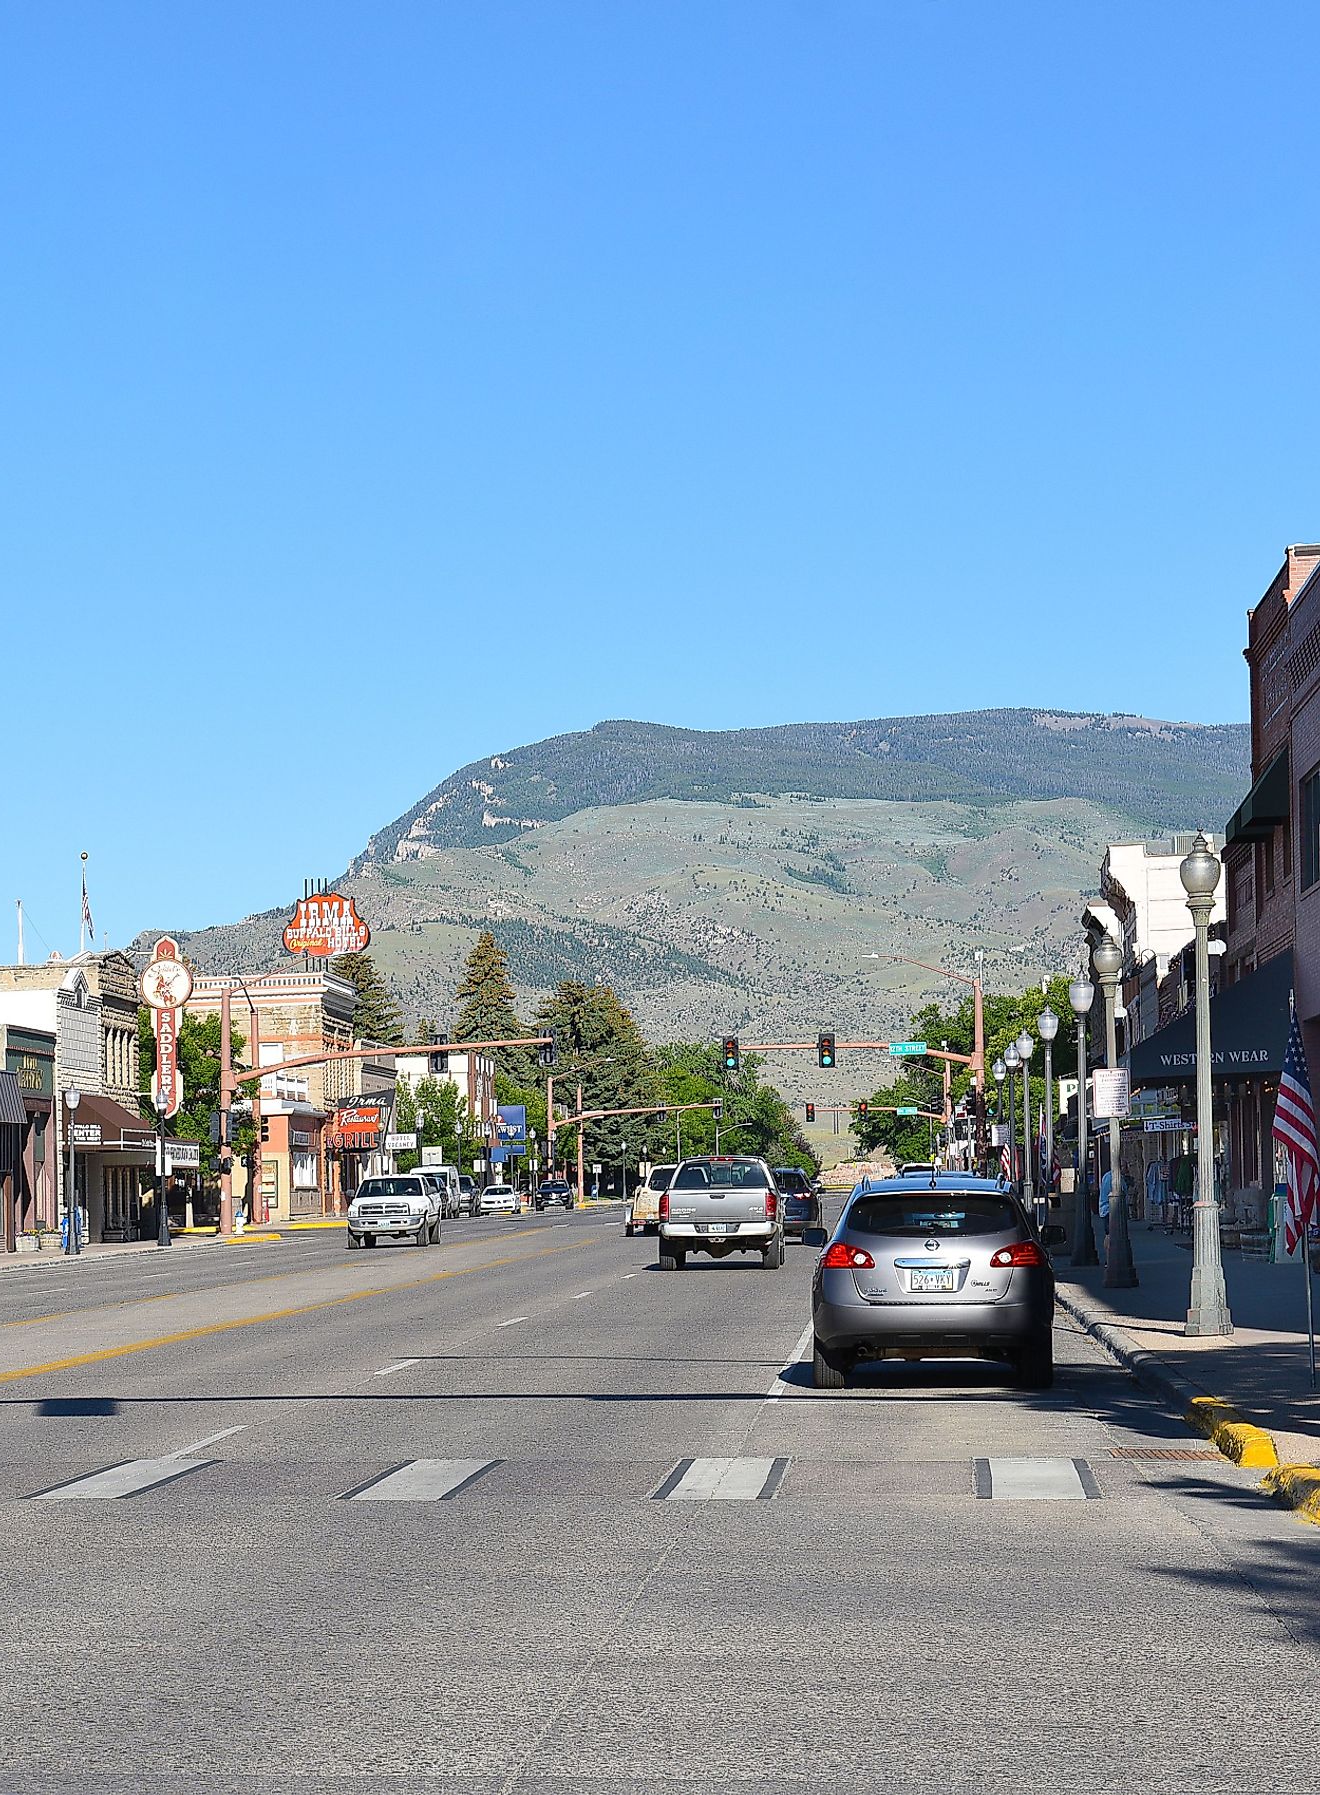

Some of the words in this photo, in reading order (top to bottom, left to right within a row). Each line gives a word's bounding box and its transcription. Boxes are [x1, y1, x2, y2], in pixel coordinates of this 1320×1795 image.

[299, 901, 354, 927] IRMA
[286, 926, 332, 940] BUFFALO
[289, 939, 324, 950] Original
[327, 936, 364, 949] HOTEL
[160, 1012, 174, 1095] SADDLERY
[905, 1044, 926, 1052] STREET
[1228, 1049, 1269, 1063] WEAR
[346, 1097, 387, 1108] Irma
[340, 1109, 379, 1126] Restaurant
[333, 1131, 377, 1148] GRILL
[913, 1274, 930, 1285] 526
[934, 1274, 952, 1285] VKY
